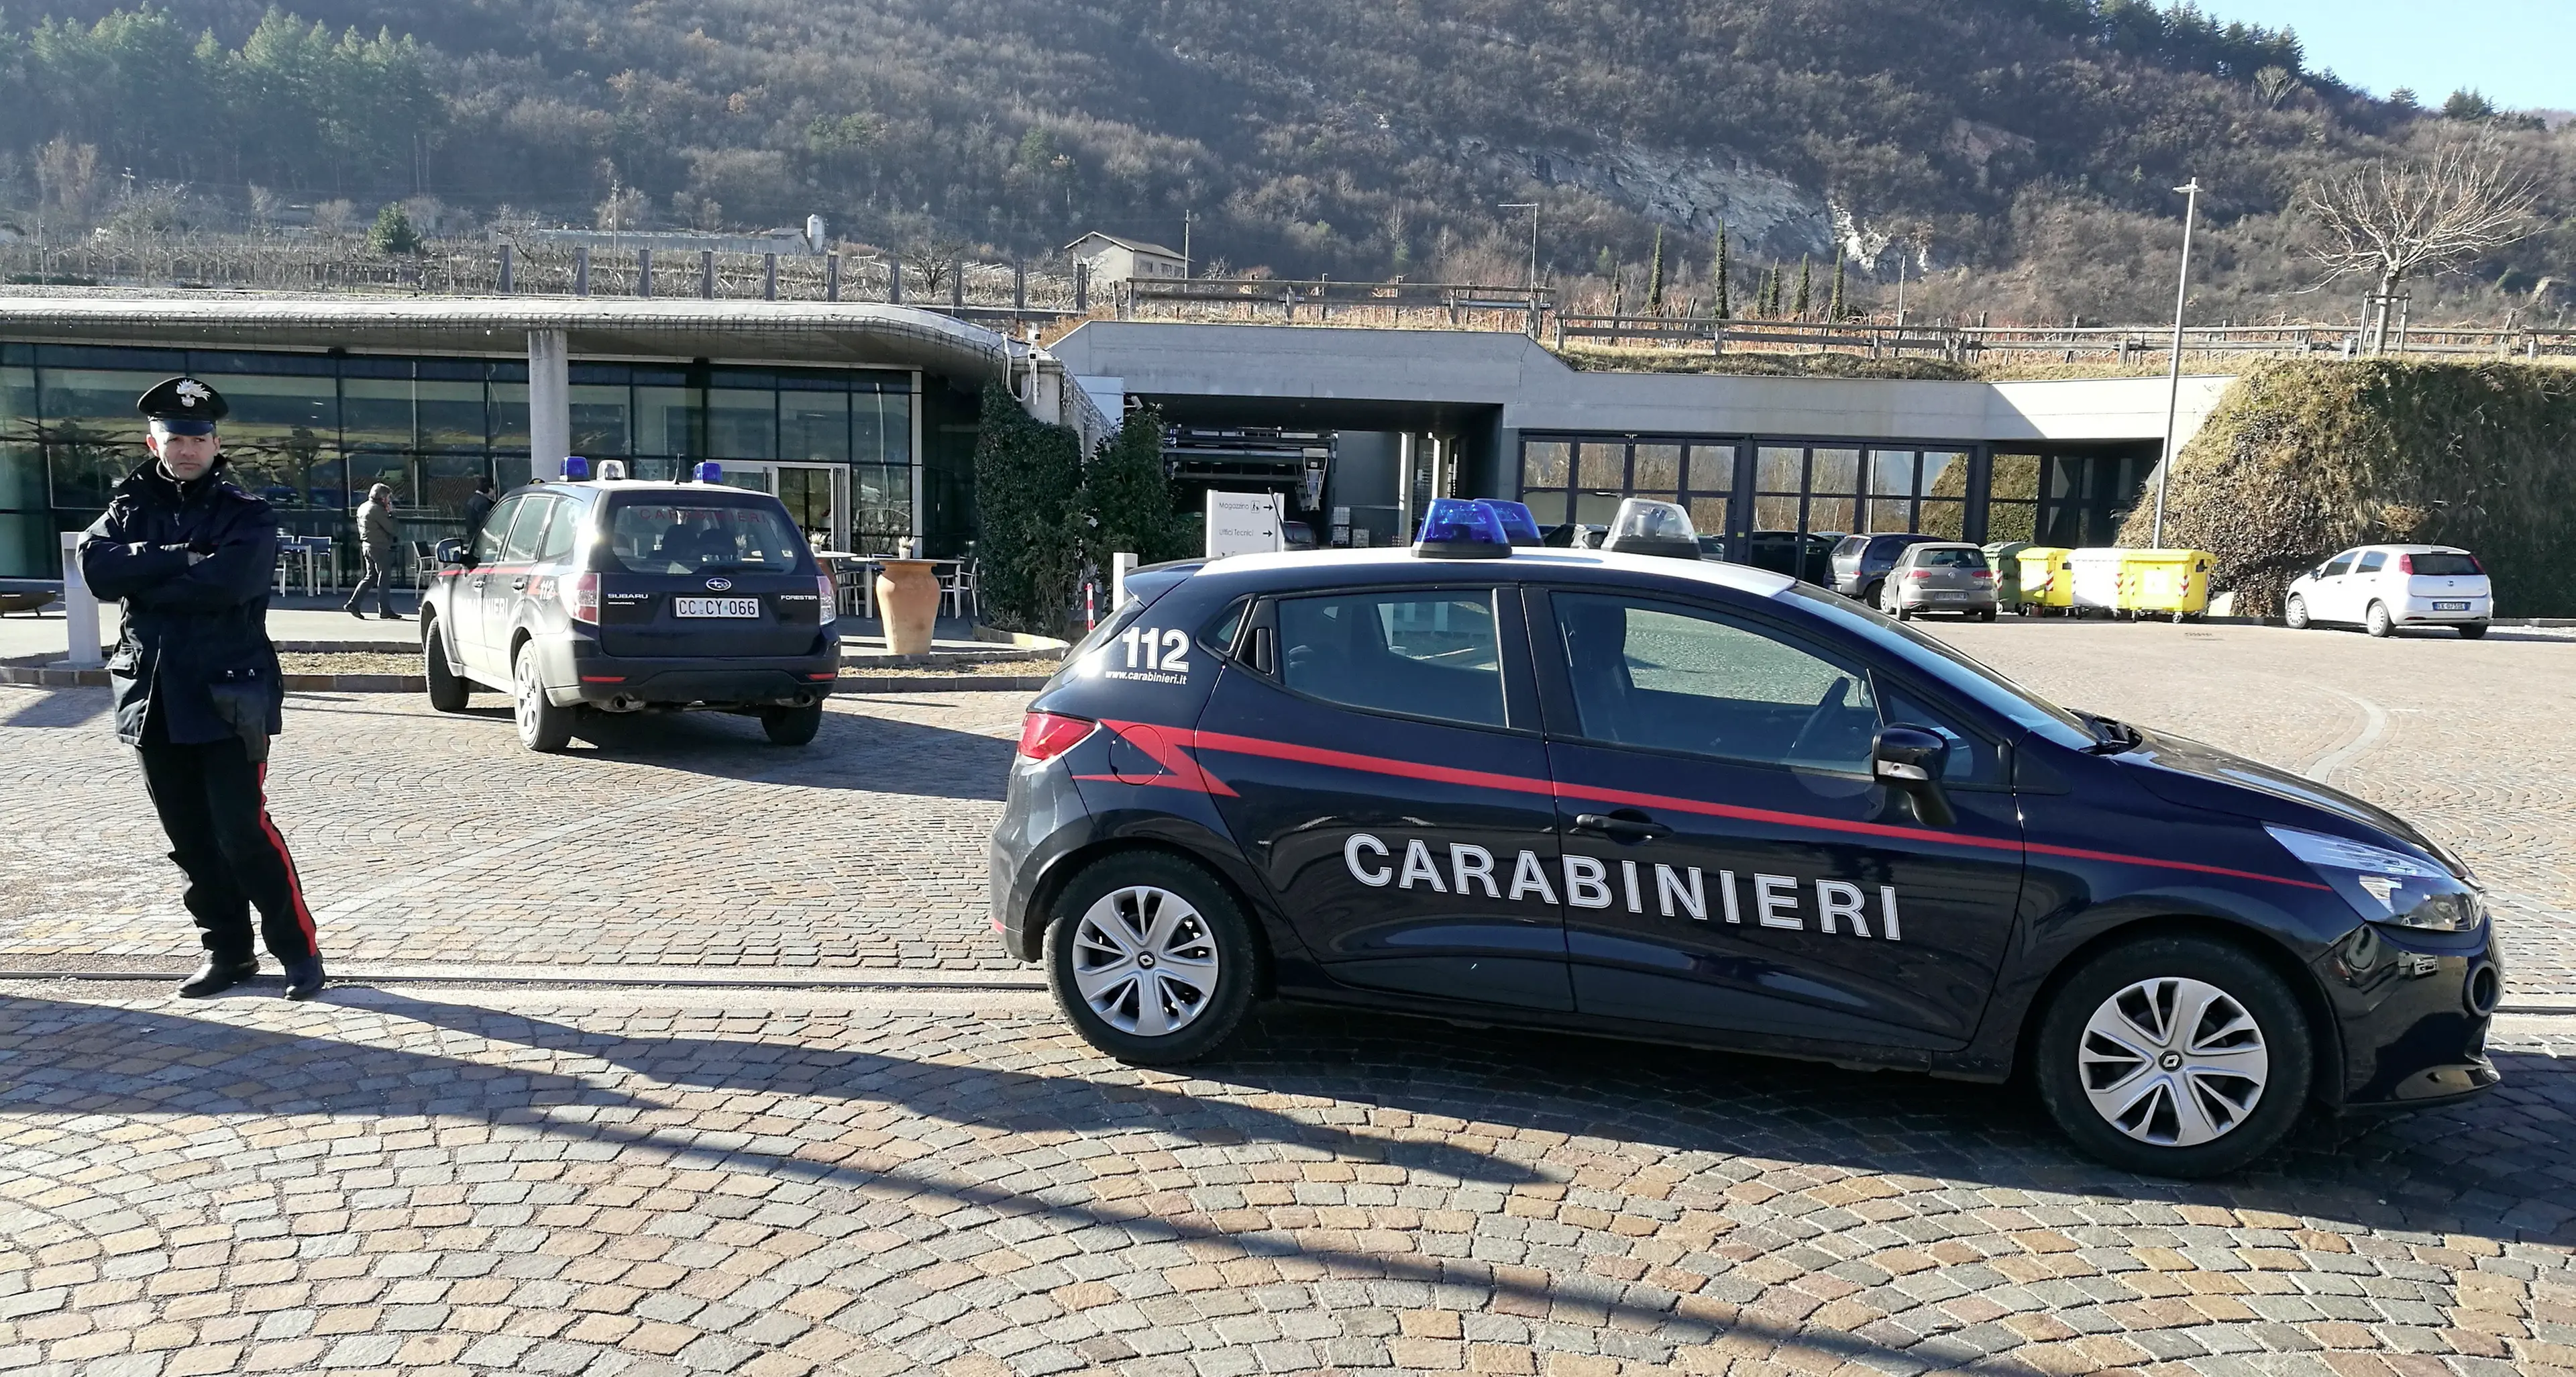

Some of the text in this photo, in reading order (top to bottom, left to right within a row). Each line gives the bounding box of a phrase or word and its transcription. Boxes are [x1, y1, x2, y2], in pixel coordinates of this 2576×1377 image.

[679, 600, 696, 615] CC
[706, 600, 722, 615] CY
[729, 601, 755, 615] 066
[1122, 627, 1190, 672] 112
[1105, 670, 1187, 685] www.carabinieri.it
[1344, 832, 1902, 941] CARABINIERI
